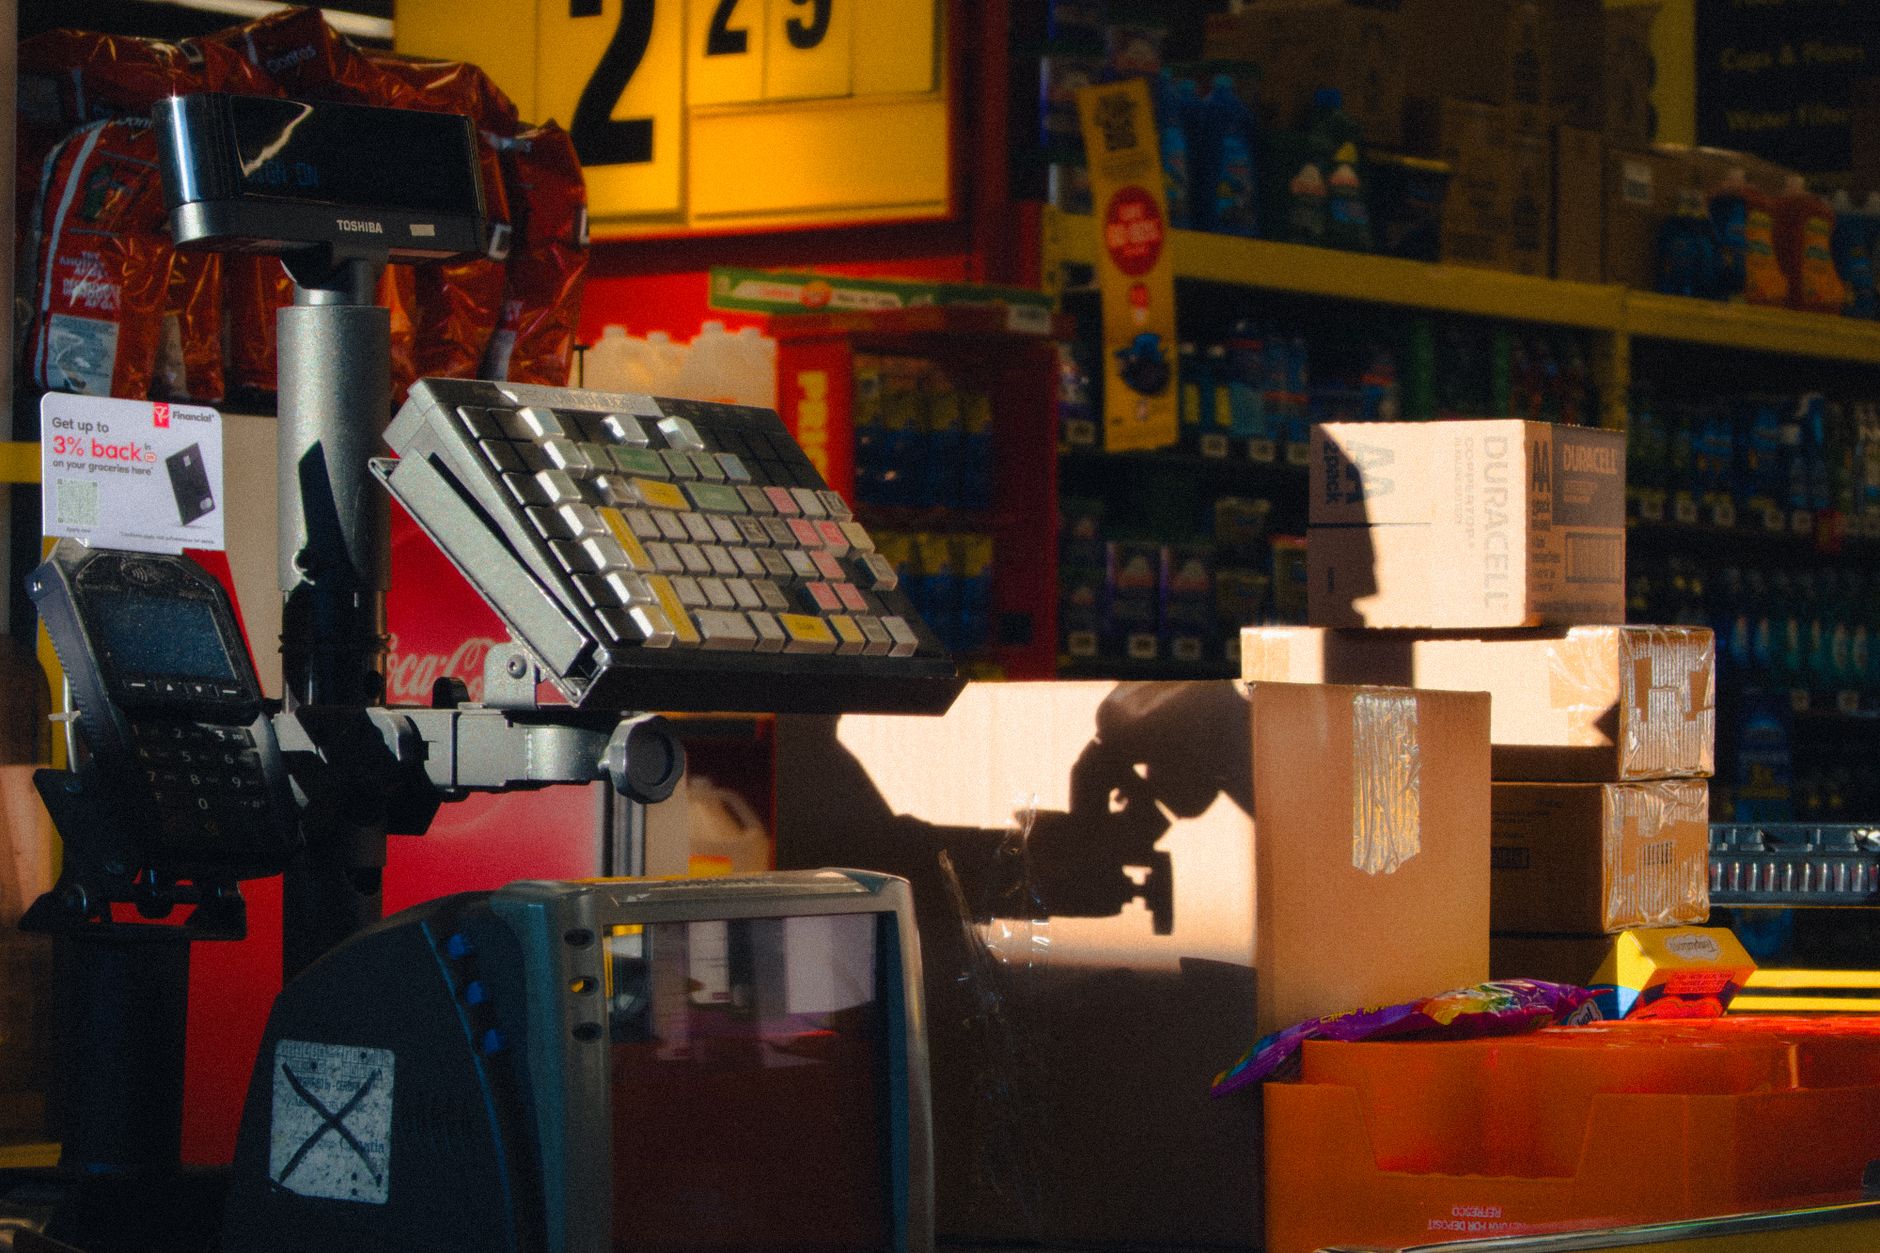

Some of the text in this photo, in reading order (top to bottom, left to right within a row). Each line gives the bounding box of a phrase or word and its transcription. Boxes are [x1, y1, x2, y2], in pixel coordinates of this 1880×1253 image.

[336, 219, 383, 234] TOSHIBA
[172, 411, 214, 423] Financial
[52, 417, 110, 433] Get up to
[53, 436, 85, 457] 3%
[91, 438, 142, 462] back
[1563, 442, 1618, 475] DURACELL
[66, 462, 86, 473] your
[88, 463, 130, 475] groceries
[1346, 441, 1396, 506] AA
[1482, 436, 1510, 610] DURACELL
[1451, 1207, 1502, 1219] REFRESCO
[1427, 1219, 1466, 1231] DEPOSIT
[1467, 1220, 1487, 1231] FOR
